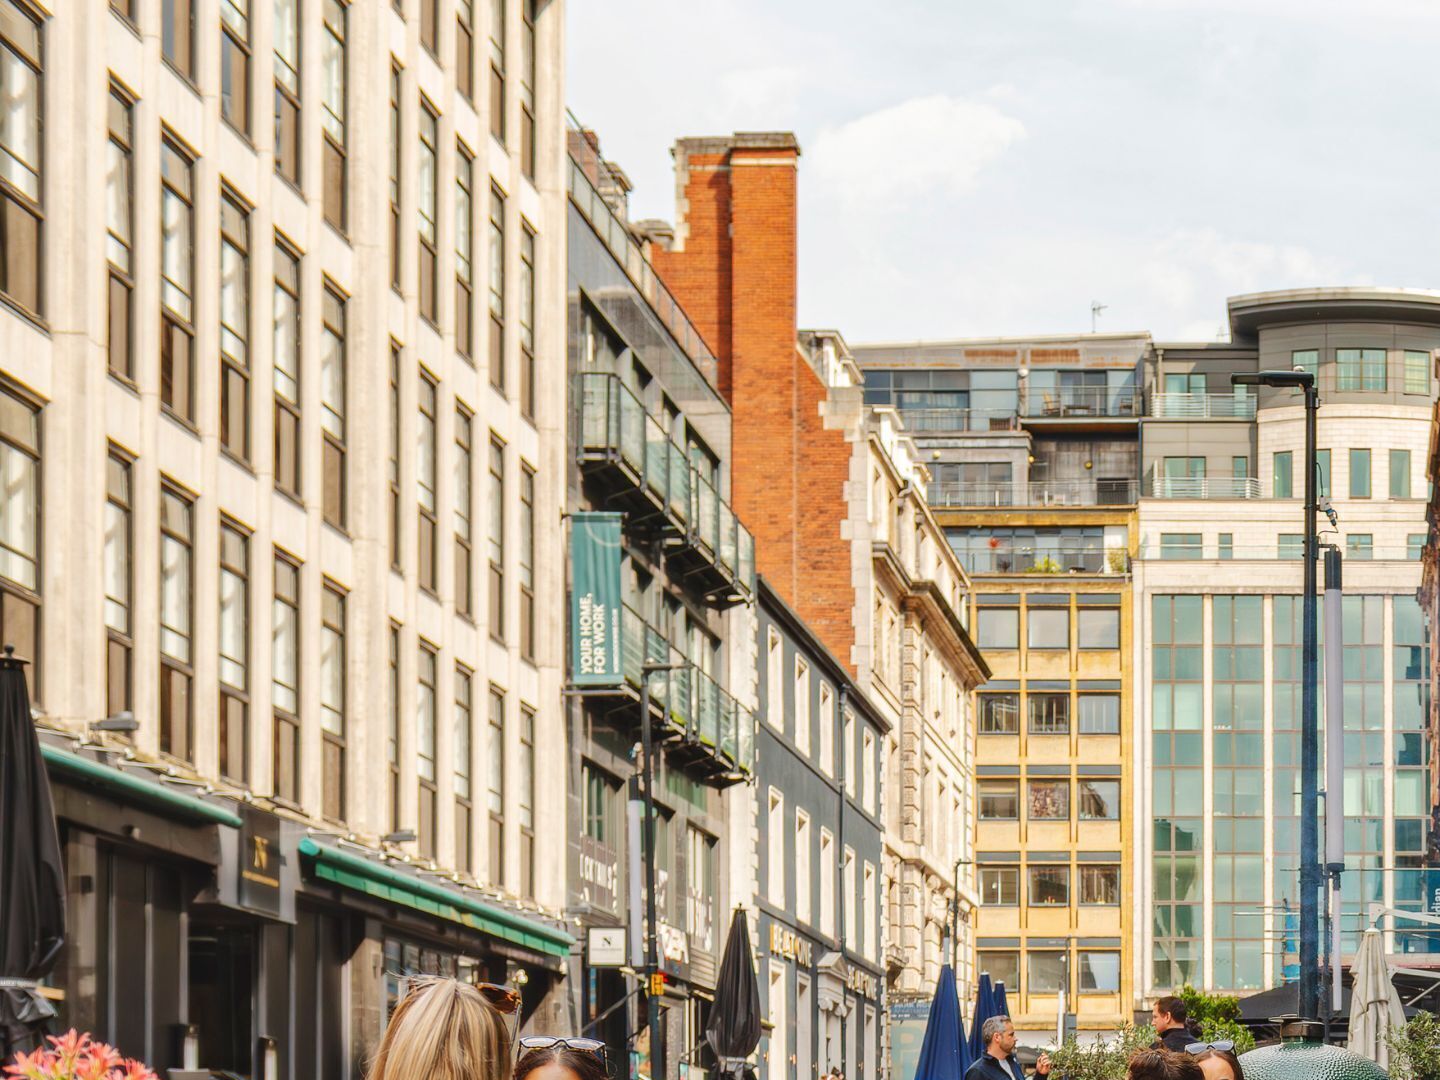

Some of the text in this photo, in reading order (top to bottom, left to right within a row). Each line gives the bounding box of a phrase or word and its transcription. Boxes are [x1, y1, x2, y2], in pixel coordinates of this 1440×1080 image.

[579, 592, 592, 674] YOUR HOME,
[592, 603, 606, 674] FOR WORK
